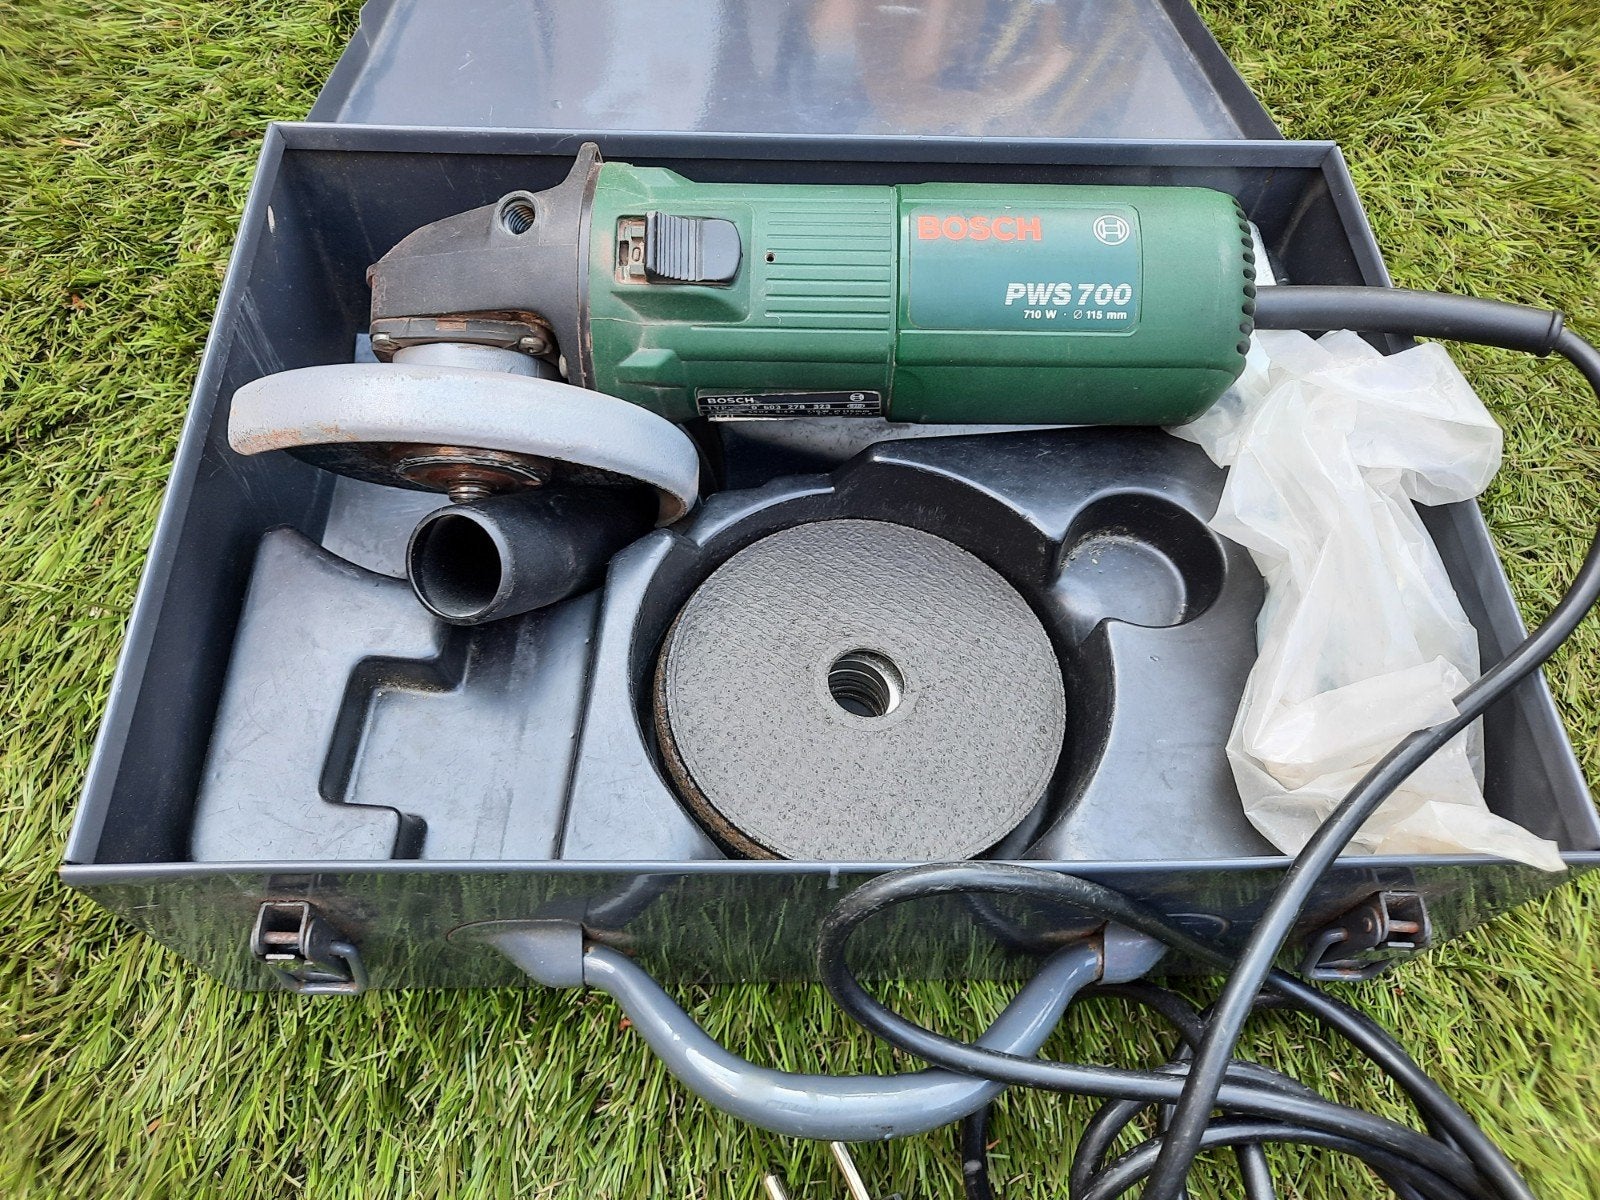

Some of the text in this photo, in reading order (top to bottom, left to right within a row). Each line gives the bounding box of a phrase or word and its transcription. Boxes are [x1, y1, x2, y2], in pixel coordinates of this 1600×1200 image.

[917, 215, 1042, 241] BOSCH
[1004, 282, 1133, 306] PWS 700
[1023, 309, 1042, 320] 710
[1045, 309, 1057, 320] W
[1086, 310, 1103, 320] 115
[1106, 311, 1127, 320] mm
